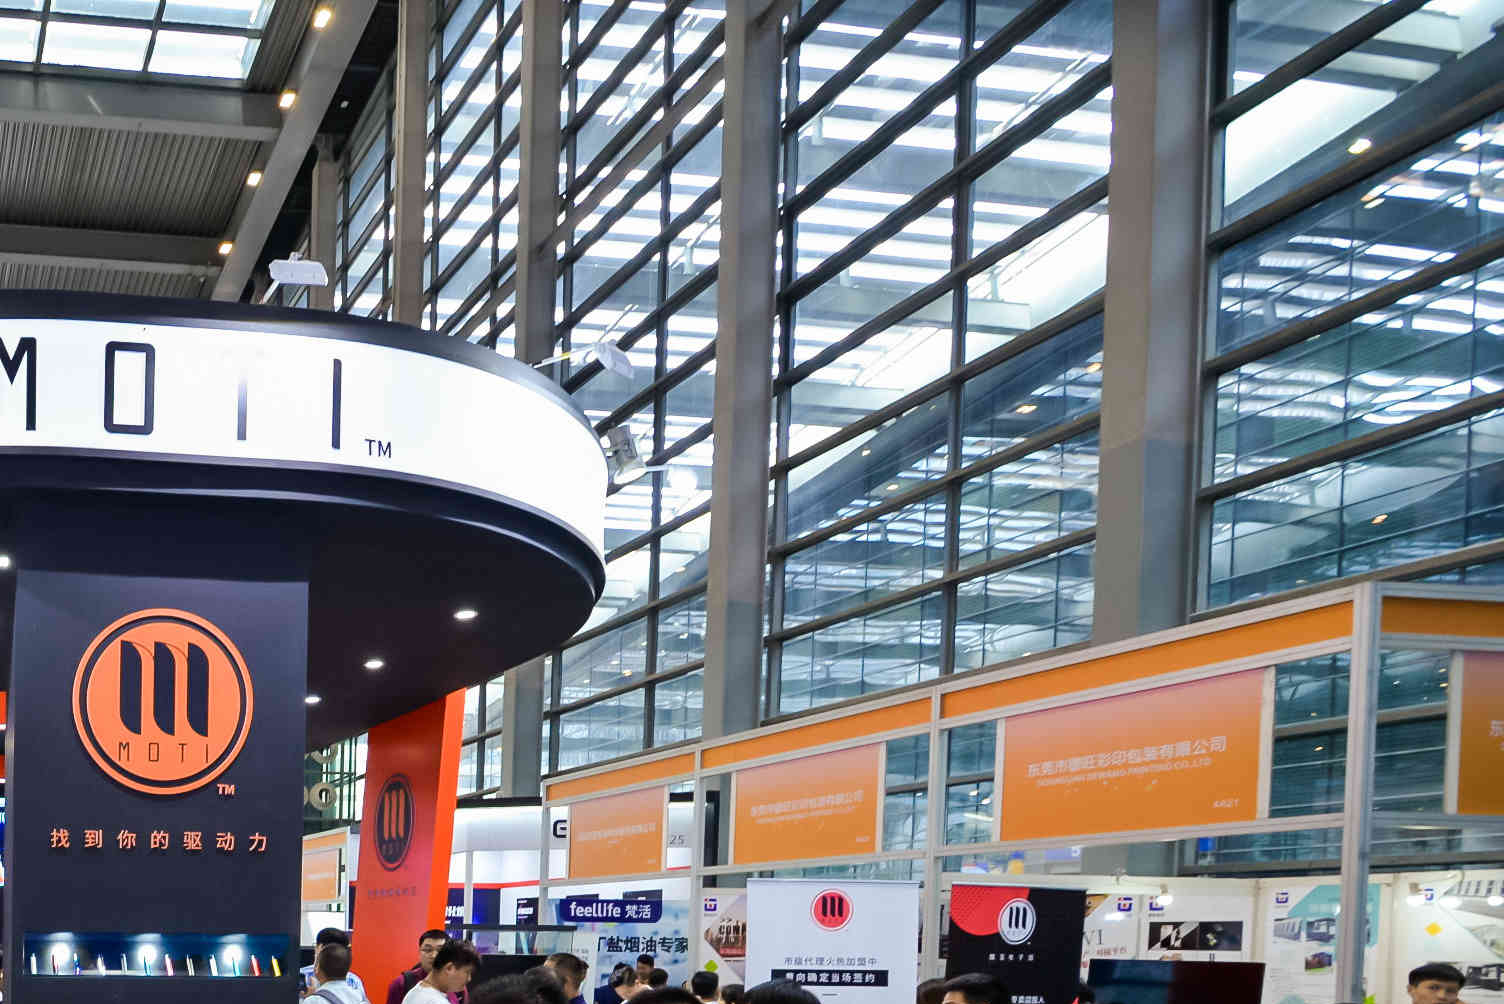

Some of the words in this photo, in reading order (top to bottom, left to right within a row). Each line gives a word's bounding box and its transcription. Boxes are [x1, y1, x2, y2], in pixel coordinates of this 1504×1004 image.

[118, 741, 209, 764] MOTI
[50, 828, 267, 852] 找到你的驱动力
[569, 902, 621, 918] feellife
[625, 904, 652, 918] 梵活
